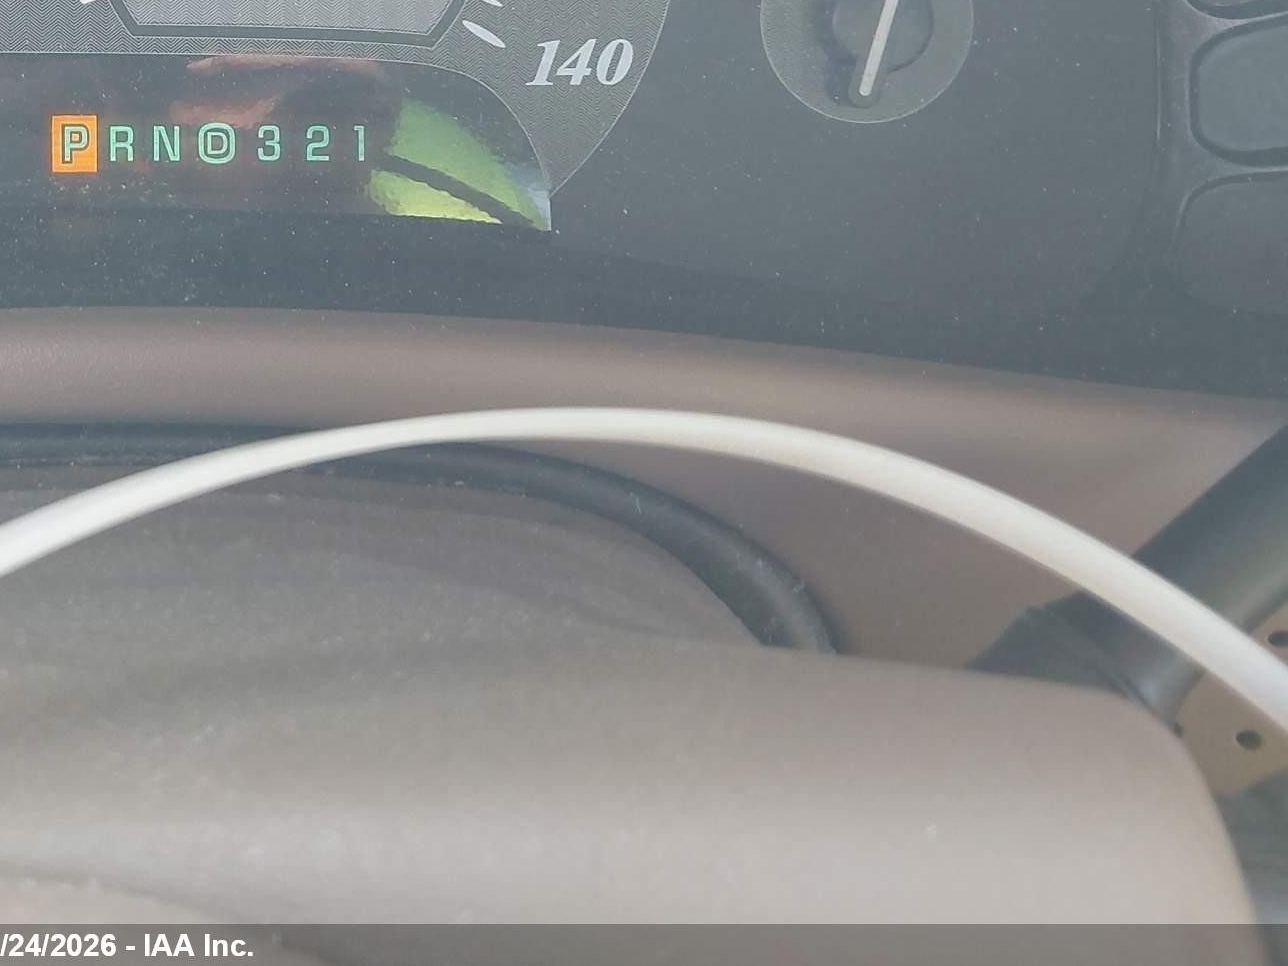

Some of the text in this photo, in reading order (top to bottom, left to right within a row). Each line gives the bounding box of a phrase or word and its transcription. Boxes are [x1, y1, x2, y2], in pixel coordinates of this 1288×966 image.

[526, 38, 634, 86] 140
[62, 124, 89, 163] P
[110, 125, 135, 162] R
[153, 125, 181, 162] N
[257, 125, 281, 161] 3
[306, 125, 330, 161] 2
[353, 125, 365, 161] 1
